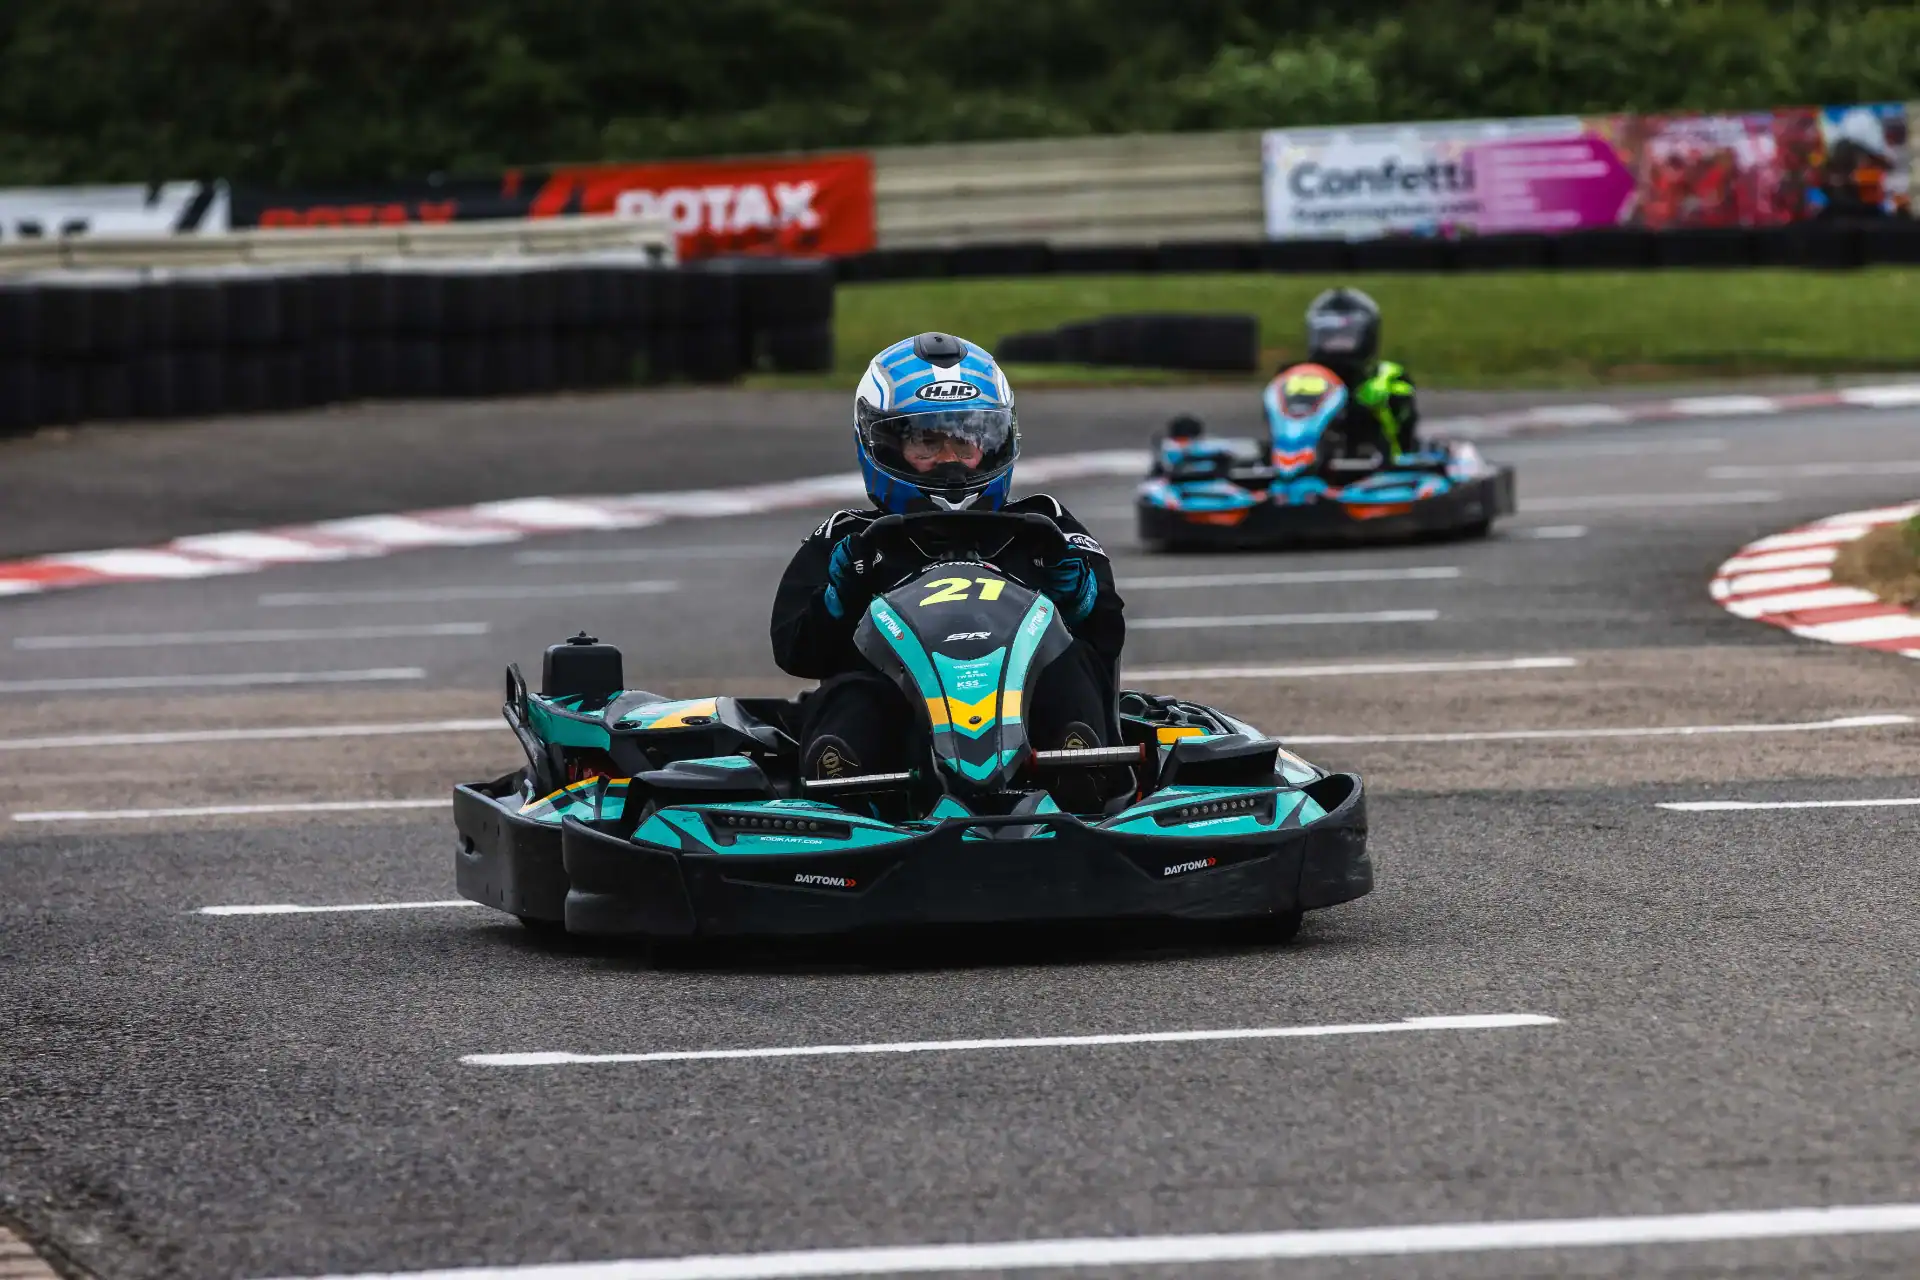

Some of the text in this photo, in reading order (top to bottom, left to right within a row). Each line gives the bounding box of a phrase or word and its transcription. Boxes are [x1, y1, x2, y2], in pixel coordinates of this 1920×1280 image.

[1287, 156, 1476, 199] Confetti
[925, 386, 973, 397] HJC
[919, 577, 1006, 606] 21
[877, 610, 902, 638] DAYTONA
[942, 631, 991, 642] SR
[957, 680, 979, 688] KSS
[1164, 858, 1208, 875] DAYTONA
[795, 873, 845, 886] DAYTONA
